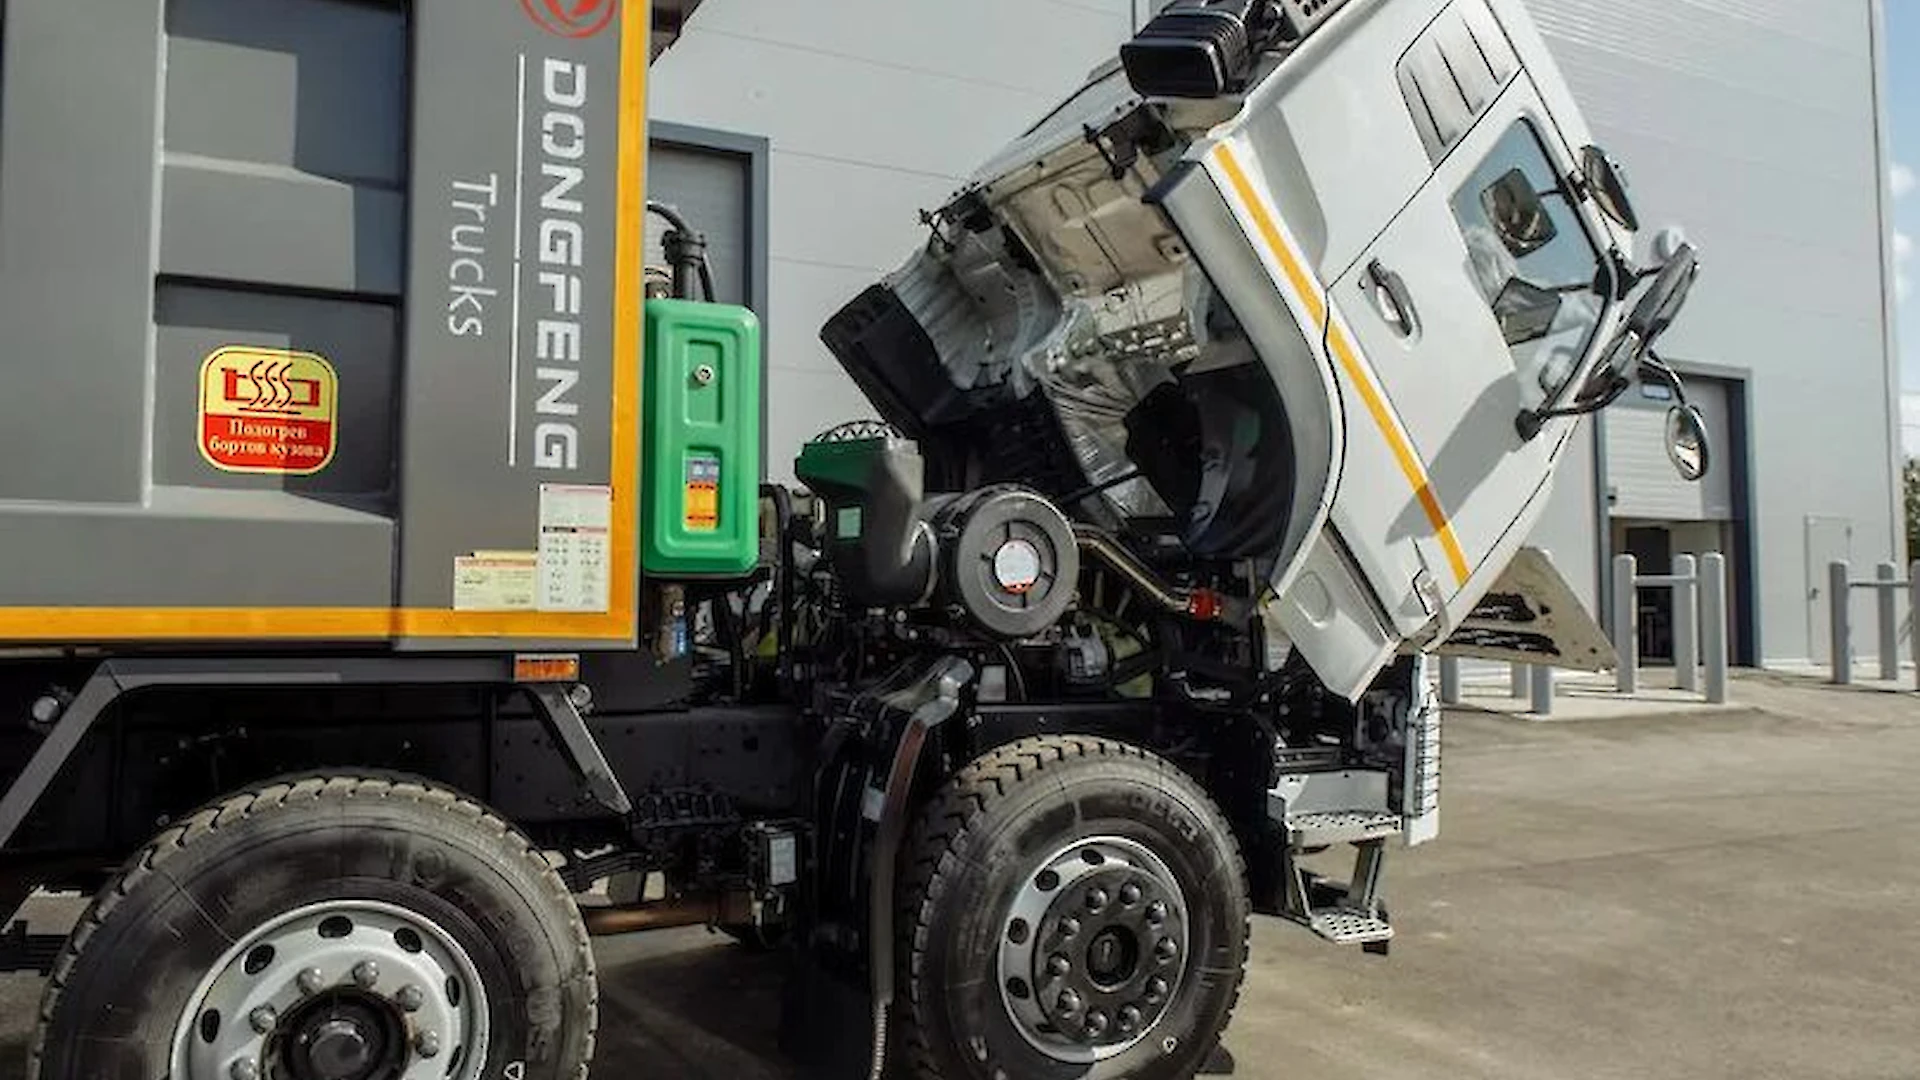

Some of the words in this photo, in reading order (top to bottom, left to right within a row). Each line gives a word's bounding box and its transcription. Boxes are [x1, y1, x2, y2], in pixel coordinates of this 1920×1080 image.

[449, 173, 498, 336] Trucks
[535, 57, 587, 469] DONGFENG
[209, 434, 267, 456] бортов
[268, 442, 324, 460] кузова
[229, 418, 307, 441] Подогрев
